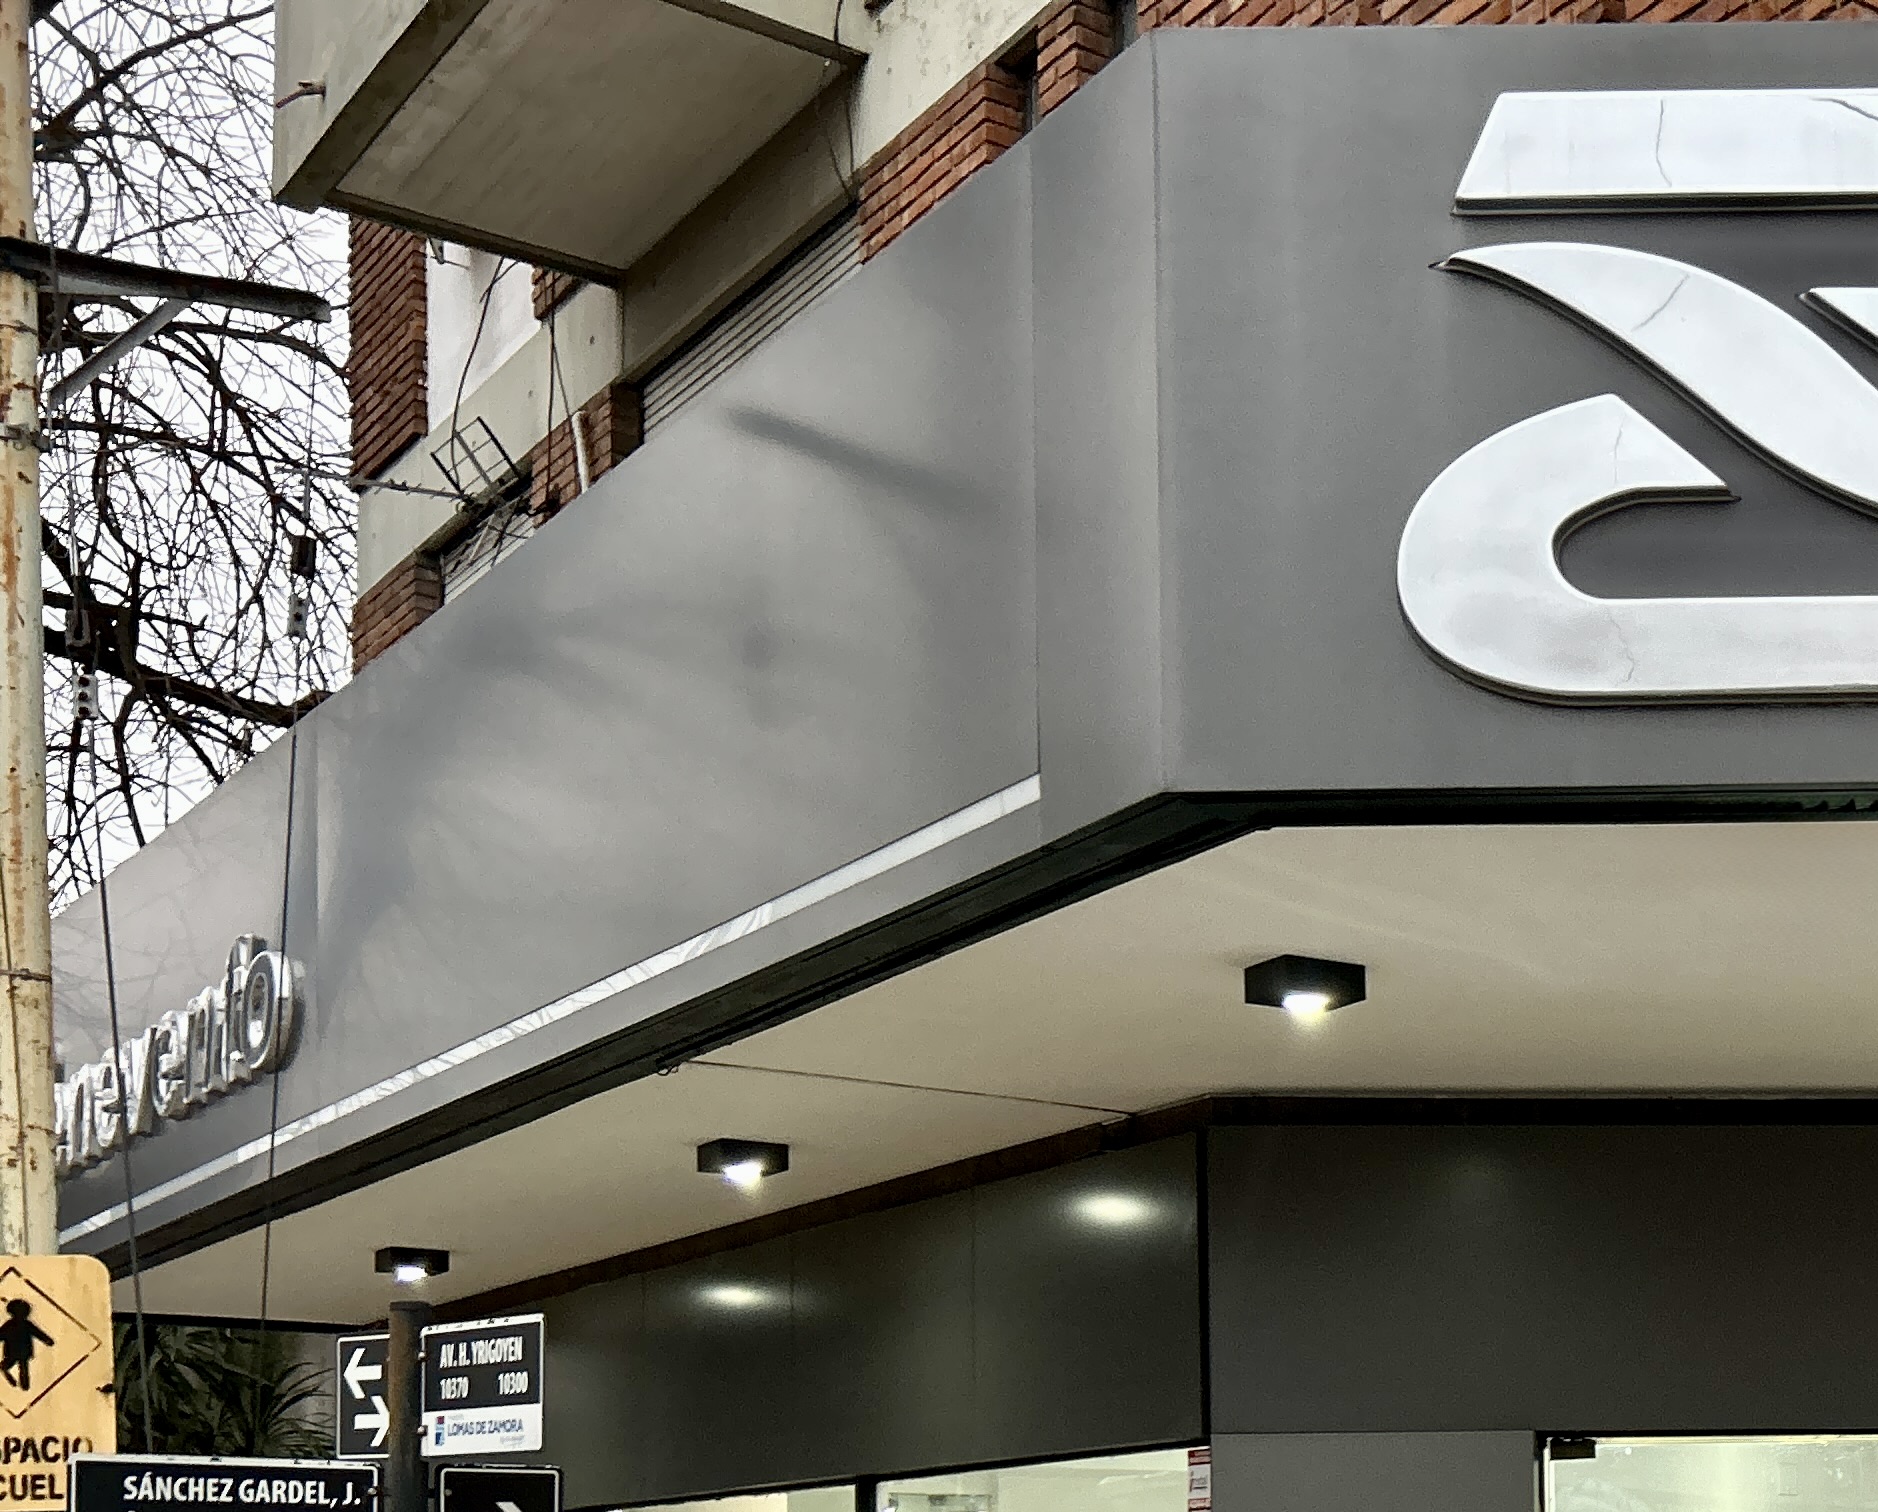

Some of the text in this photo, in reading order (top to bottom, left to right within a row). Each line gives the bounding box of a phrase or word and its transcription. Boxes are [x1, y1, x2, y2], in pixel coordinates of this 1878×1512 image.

[439, 1335, 523, 1369] AV. H. YRIGOYEN
[440, 1371, 528, 1400] 10370 10300
[447, 1418, 524, 1437] LOMAS DE ZAMORA
[0, 1435, 93, 1465] PACIO
[122, 1472, 362, 1509] SÁNCHEZ GARDEL, J.
